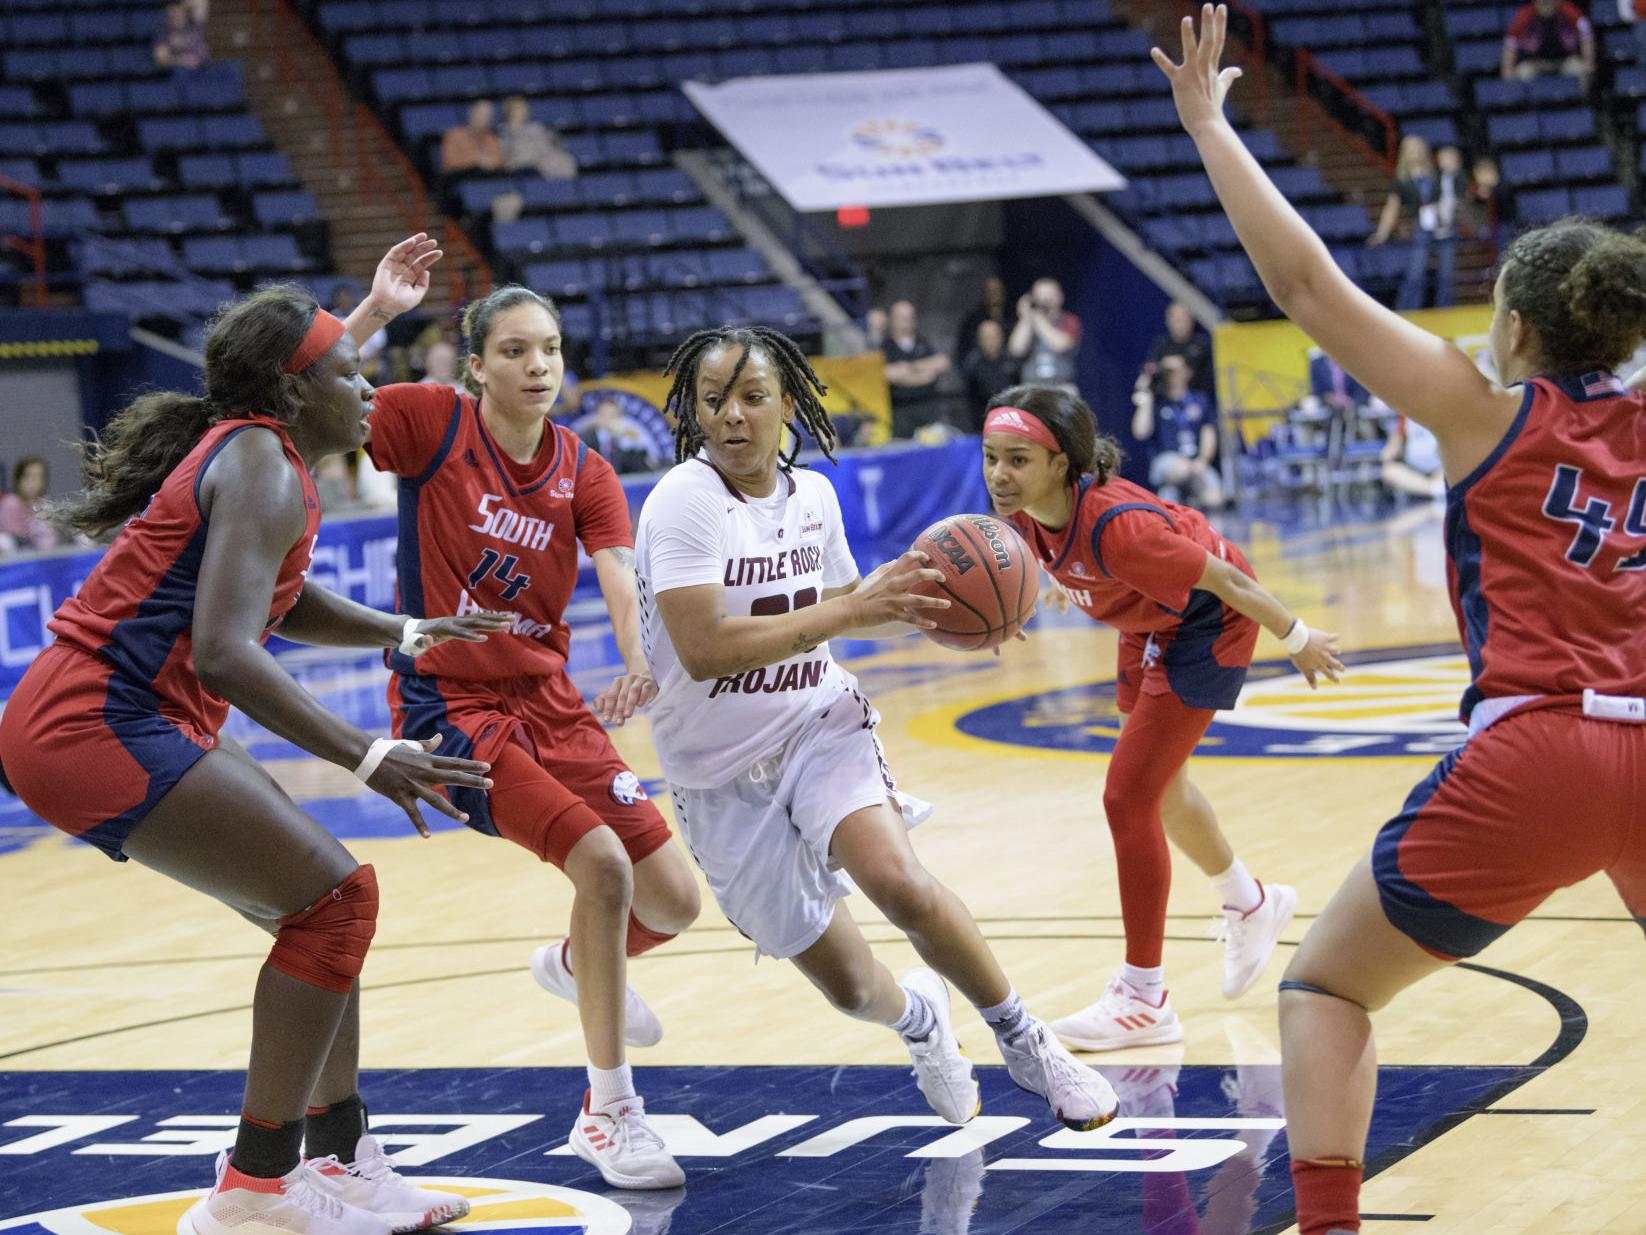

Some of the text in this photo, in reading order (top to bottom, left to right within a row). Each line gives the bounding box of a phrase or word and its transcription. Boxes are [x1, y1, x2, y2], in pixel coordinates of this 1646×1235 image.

[467, 493, 555, 551] SOUTH
[964, 515, 1011, 570] ilson
[467, 547, 531, 602] 14
[723, 551, 788, 587] LITTLE
[929, 526, 976, 575] NCAA
